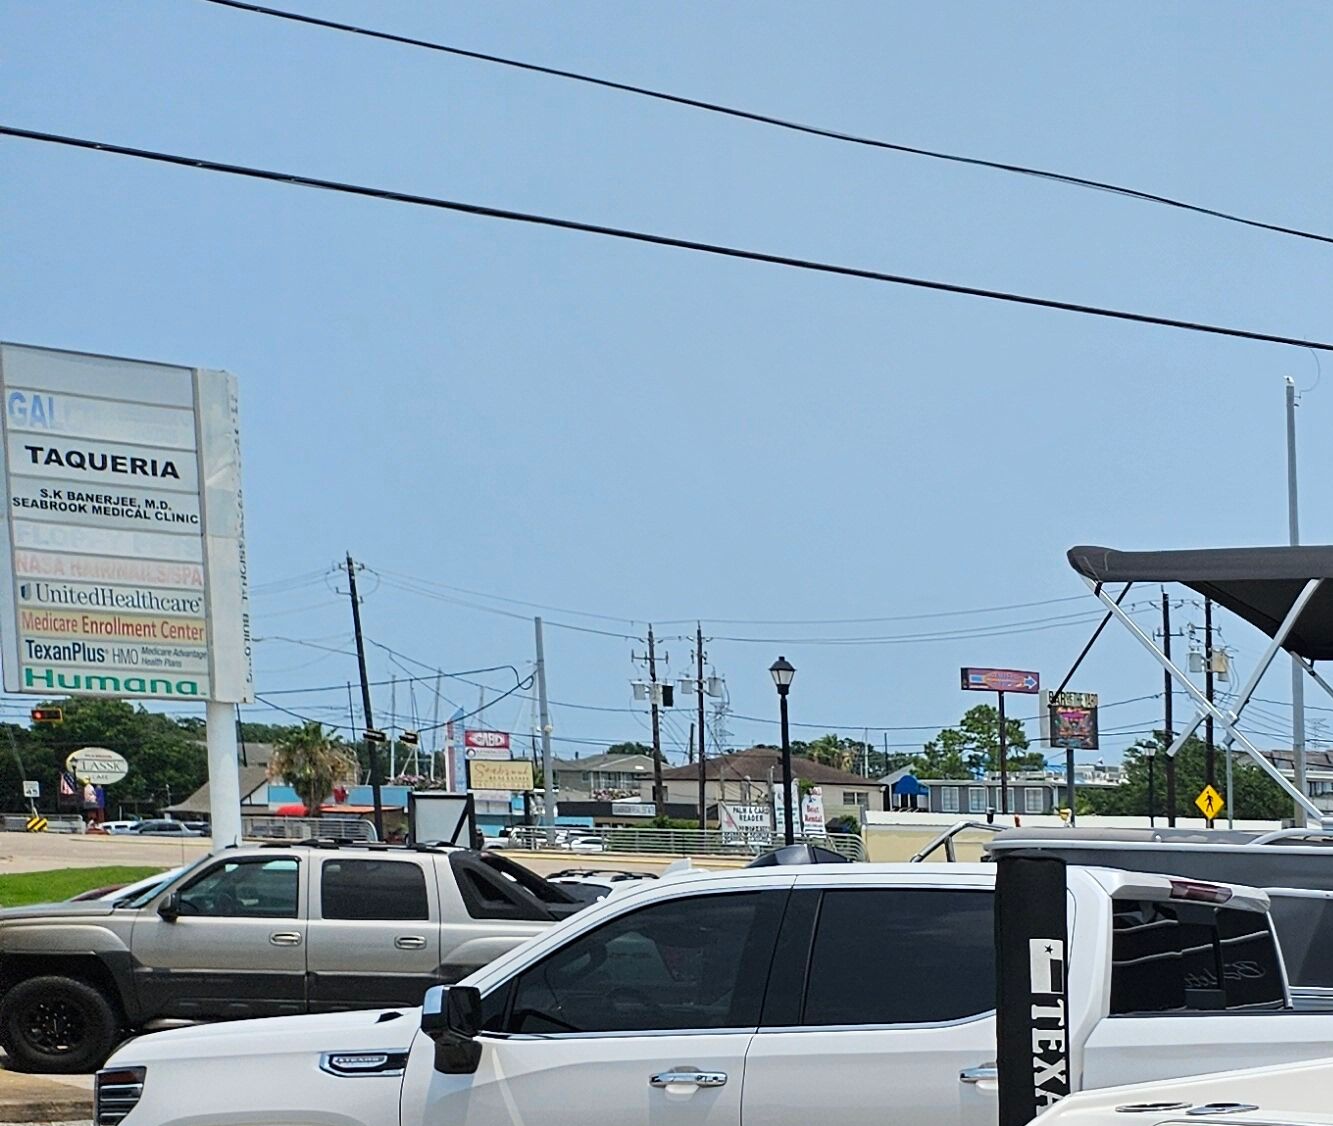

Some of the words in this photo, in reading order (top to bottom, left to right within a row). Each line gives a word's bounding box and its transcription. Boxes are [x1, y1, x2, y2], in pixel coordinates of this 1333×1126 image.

[25, 445, 180, 479] TAQUERIA
[12, 496, 88, 515] SEABROOK
[92, 504, 151, 520] MEDICAL
[155, 511, 199, 525] CLINIC
[40, 488, 63, 501] S.K
[67, 490, 141, 509] BANERJEE,
[145, 499, 172, 511] M.D.
[36, 583, 202, 613] UnitedHealthcare
[22, 611, 78, 634] Medicare
[82, 615, 157, 639] Enrollment
[161, 621, 205, 641] Center
[25, 640, 106, 663] TexanPlus
[113, 650, 138, 664] HMO
[141, 647, 170, 657] Medicare
[173, 648, 206, 659] Advantage
